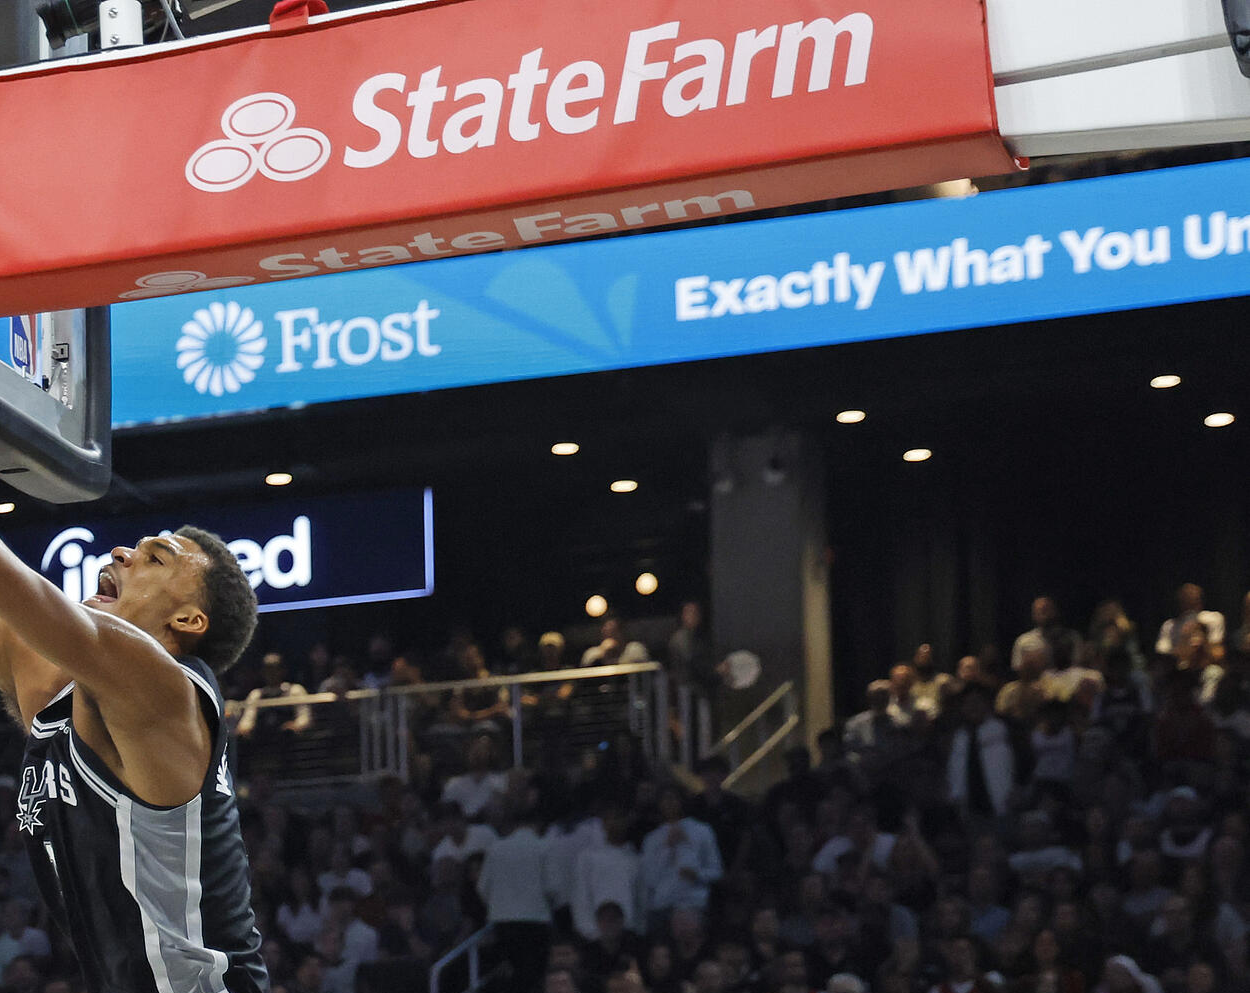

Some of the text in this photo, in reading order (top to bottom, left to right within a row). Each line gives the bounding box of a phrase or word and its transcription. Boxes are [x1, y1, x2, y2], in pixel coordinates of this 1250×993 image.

[674, 252, 885, 321] Exactly
[894, 234, 1053, 295] What
[1059, 226, 1171, 274] You
[274, 299, 442, 373] Frost
